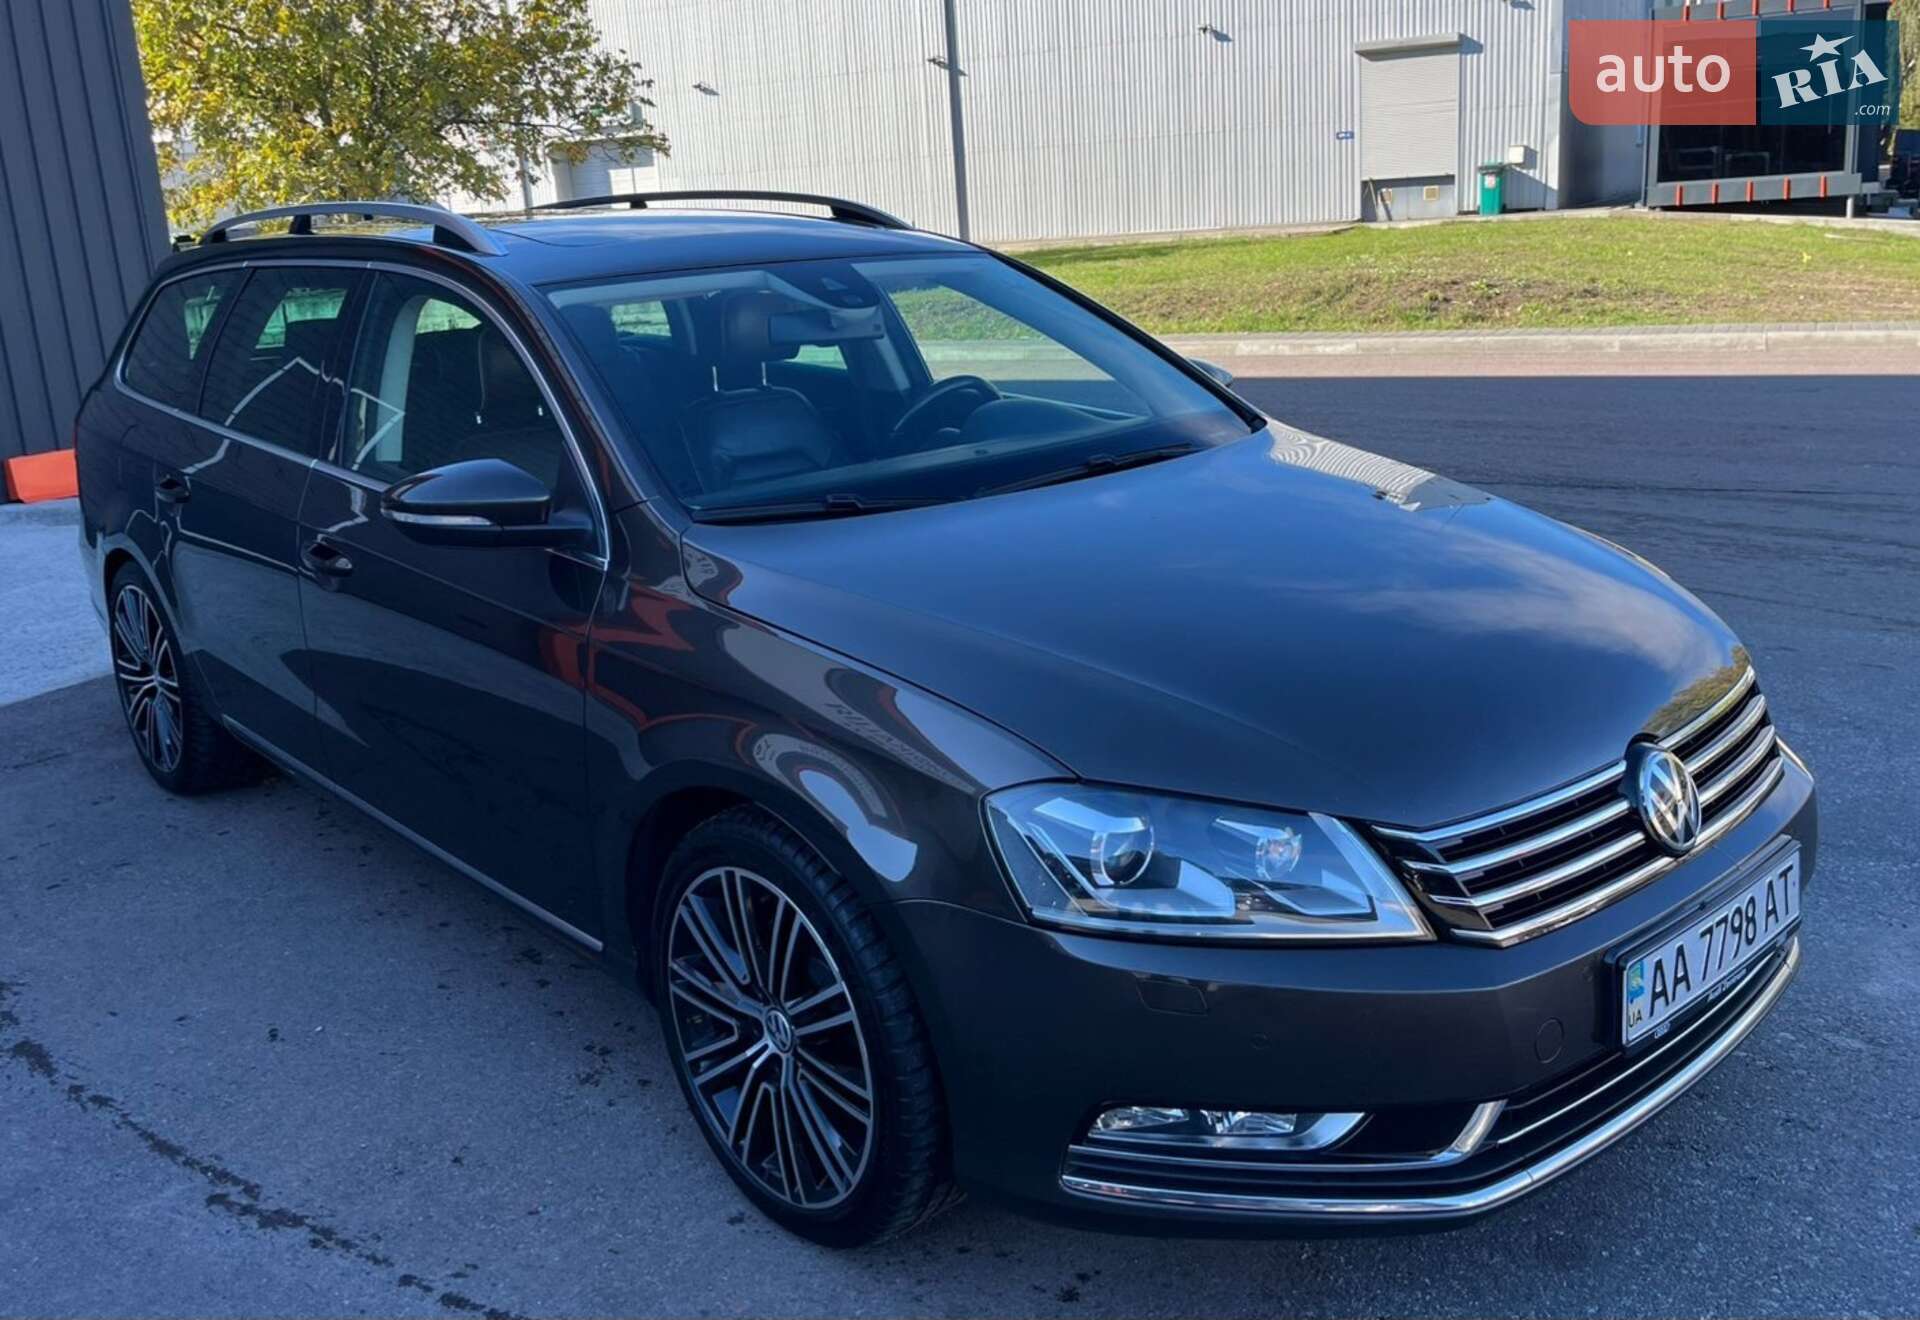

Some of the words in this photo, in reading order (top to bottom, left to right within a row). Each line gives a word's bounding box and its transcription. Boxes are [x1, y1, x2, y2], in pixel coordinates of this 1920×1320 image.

[1650, 943, 1691, 1018] AA
[1700, 895, 1757, 982] 7798
[1765, 864, 1793, 932] AT
[1628, 1009, 1643, 1028] UA
